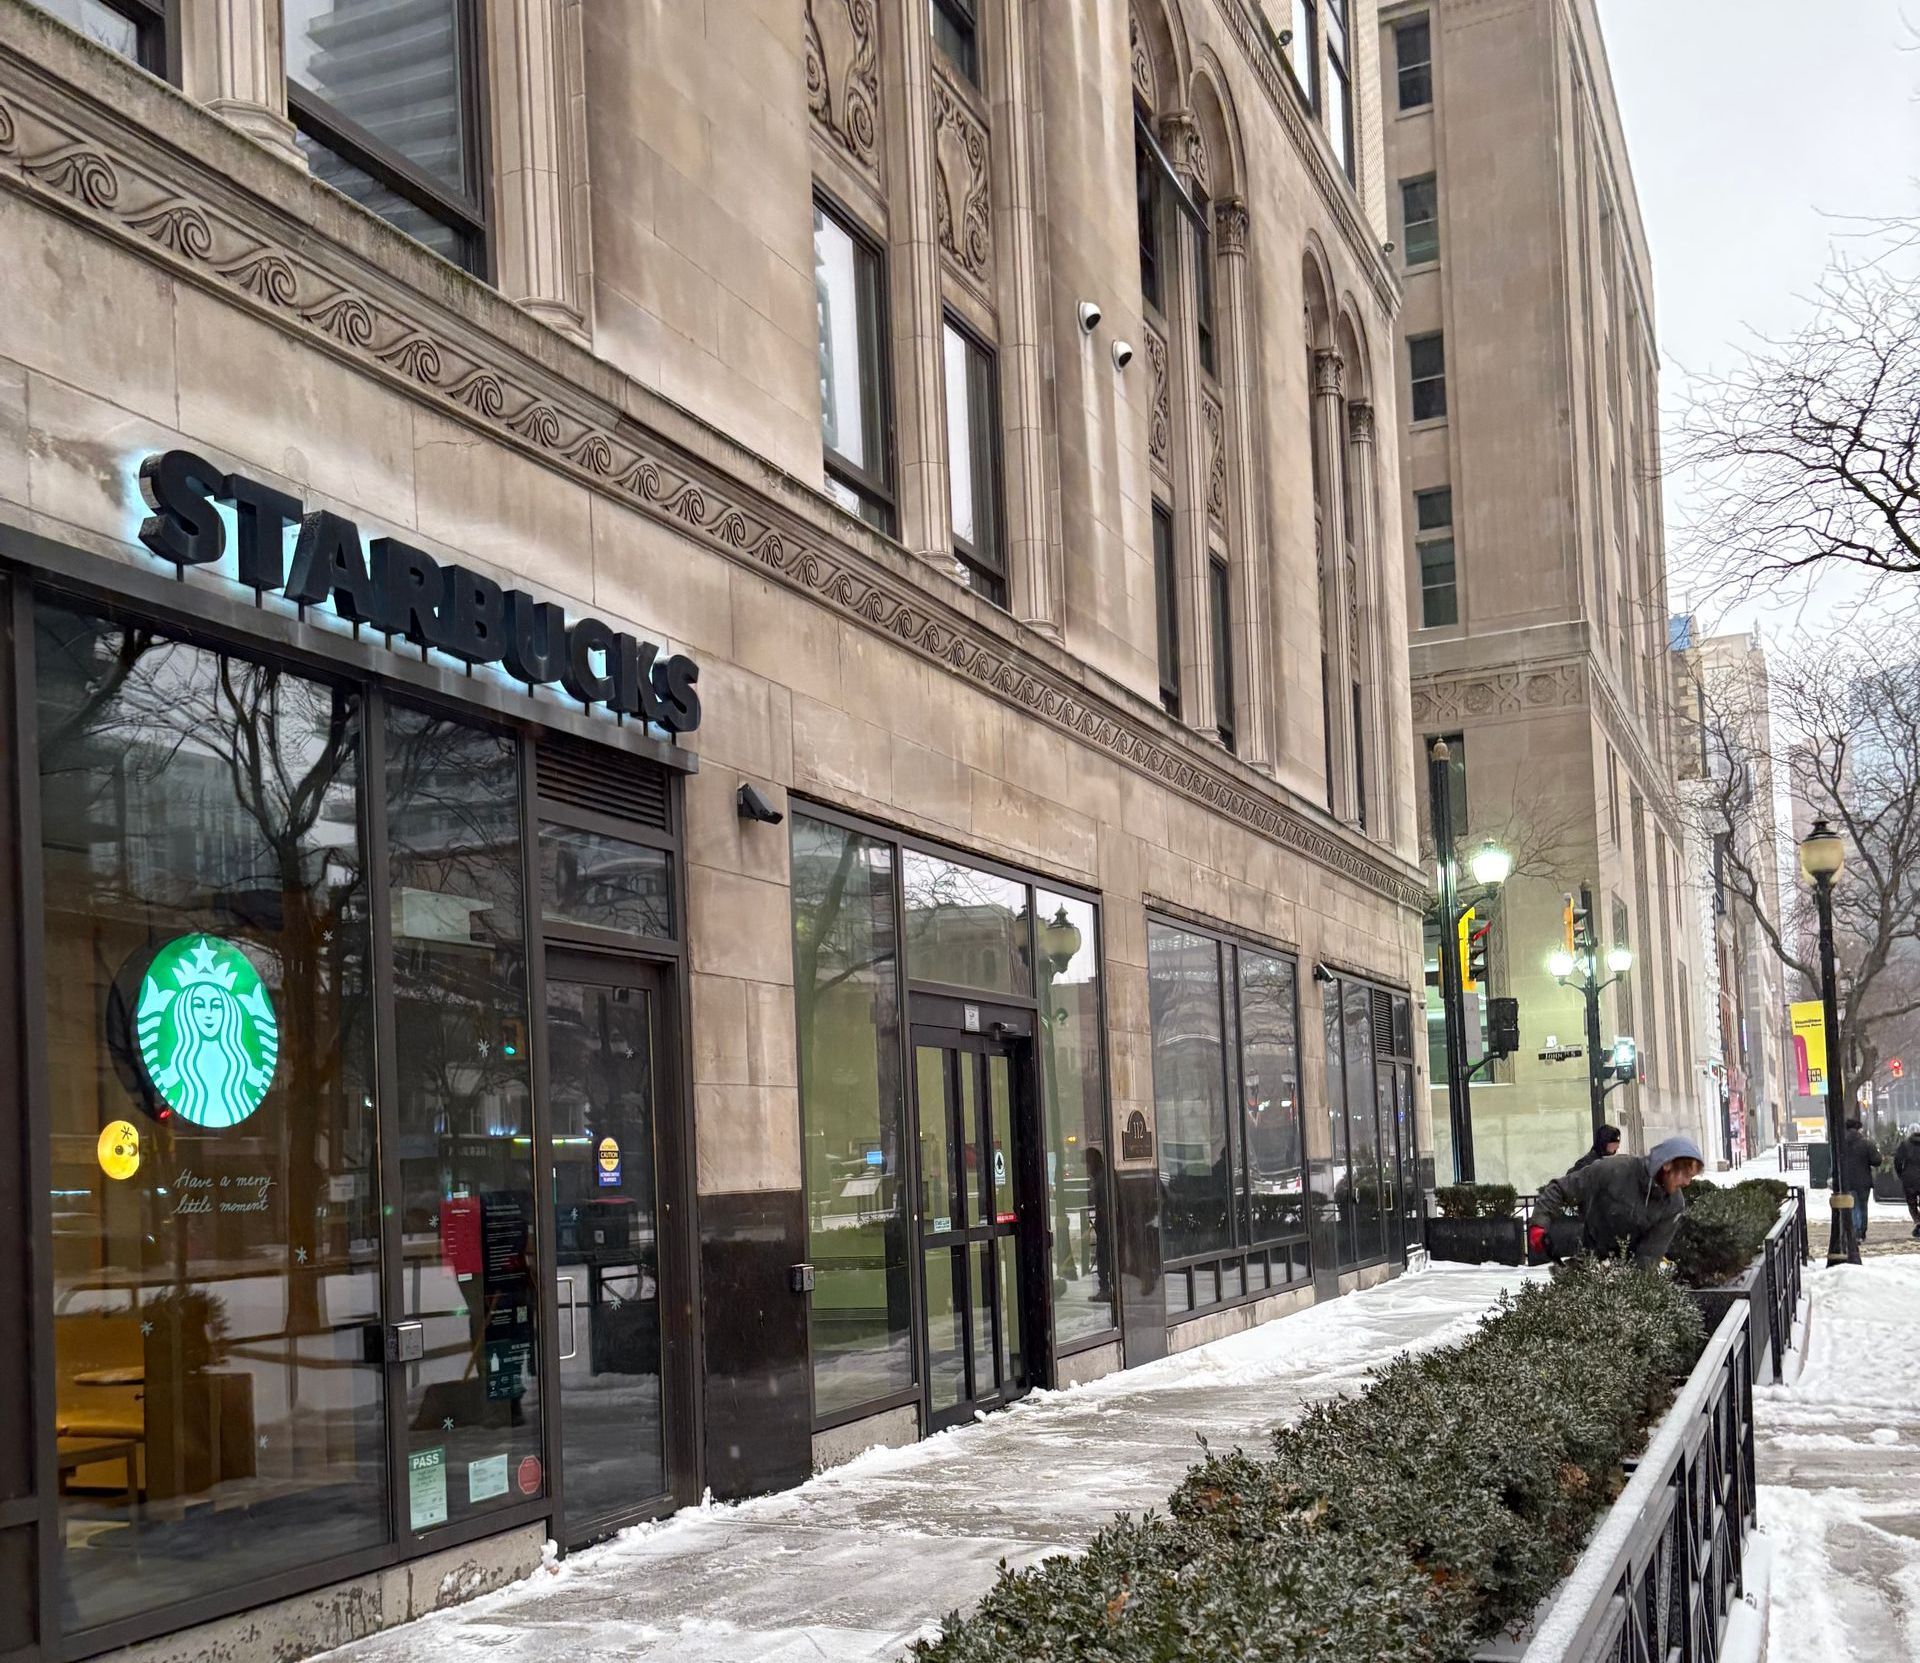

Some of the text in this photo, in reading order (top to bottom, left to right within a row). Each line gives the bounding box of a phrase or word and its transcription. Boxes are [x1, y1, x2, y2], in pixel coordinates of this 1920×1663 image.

[138, 450, 701, 732] STARBUCKS
[1545, 1052, 1563, 1060] JOHN
[1133, 1121, 1143, 1139] 112
[173, 1168, 277, 1197] Have a merry
[173, 1193, 268, 1214] little moment
[413, 1453, 440, 1470] PASS
